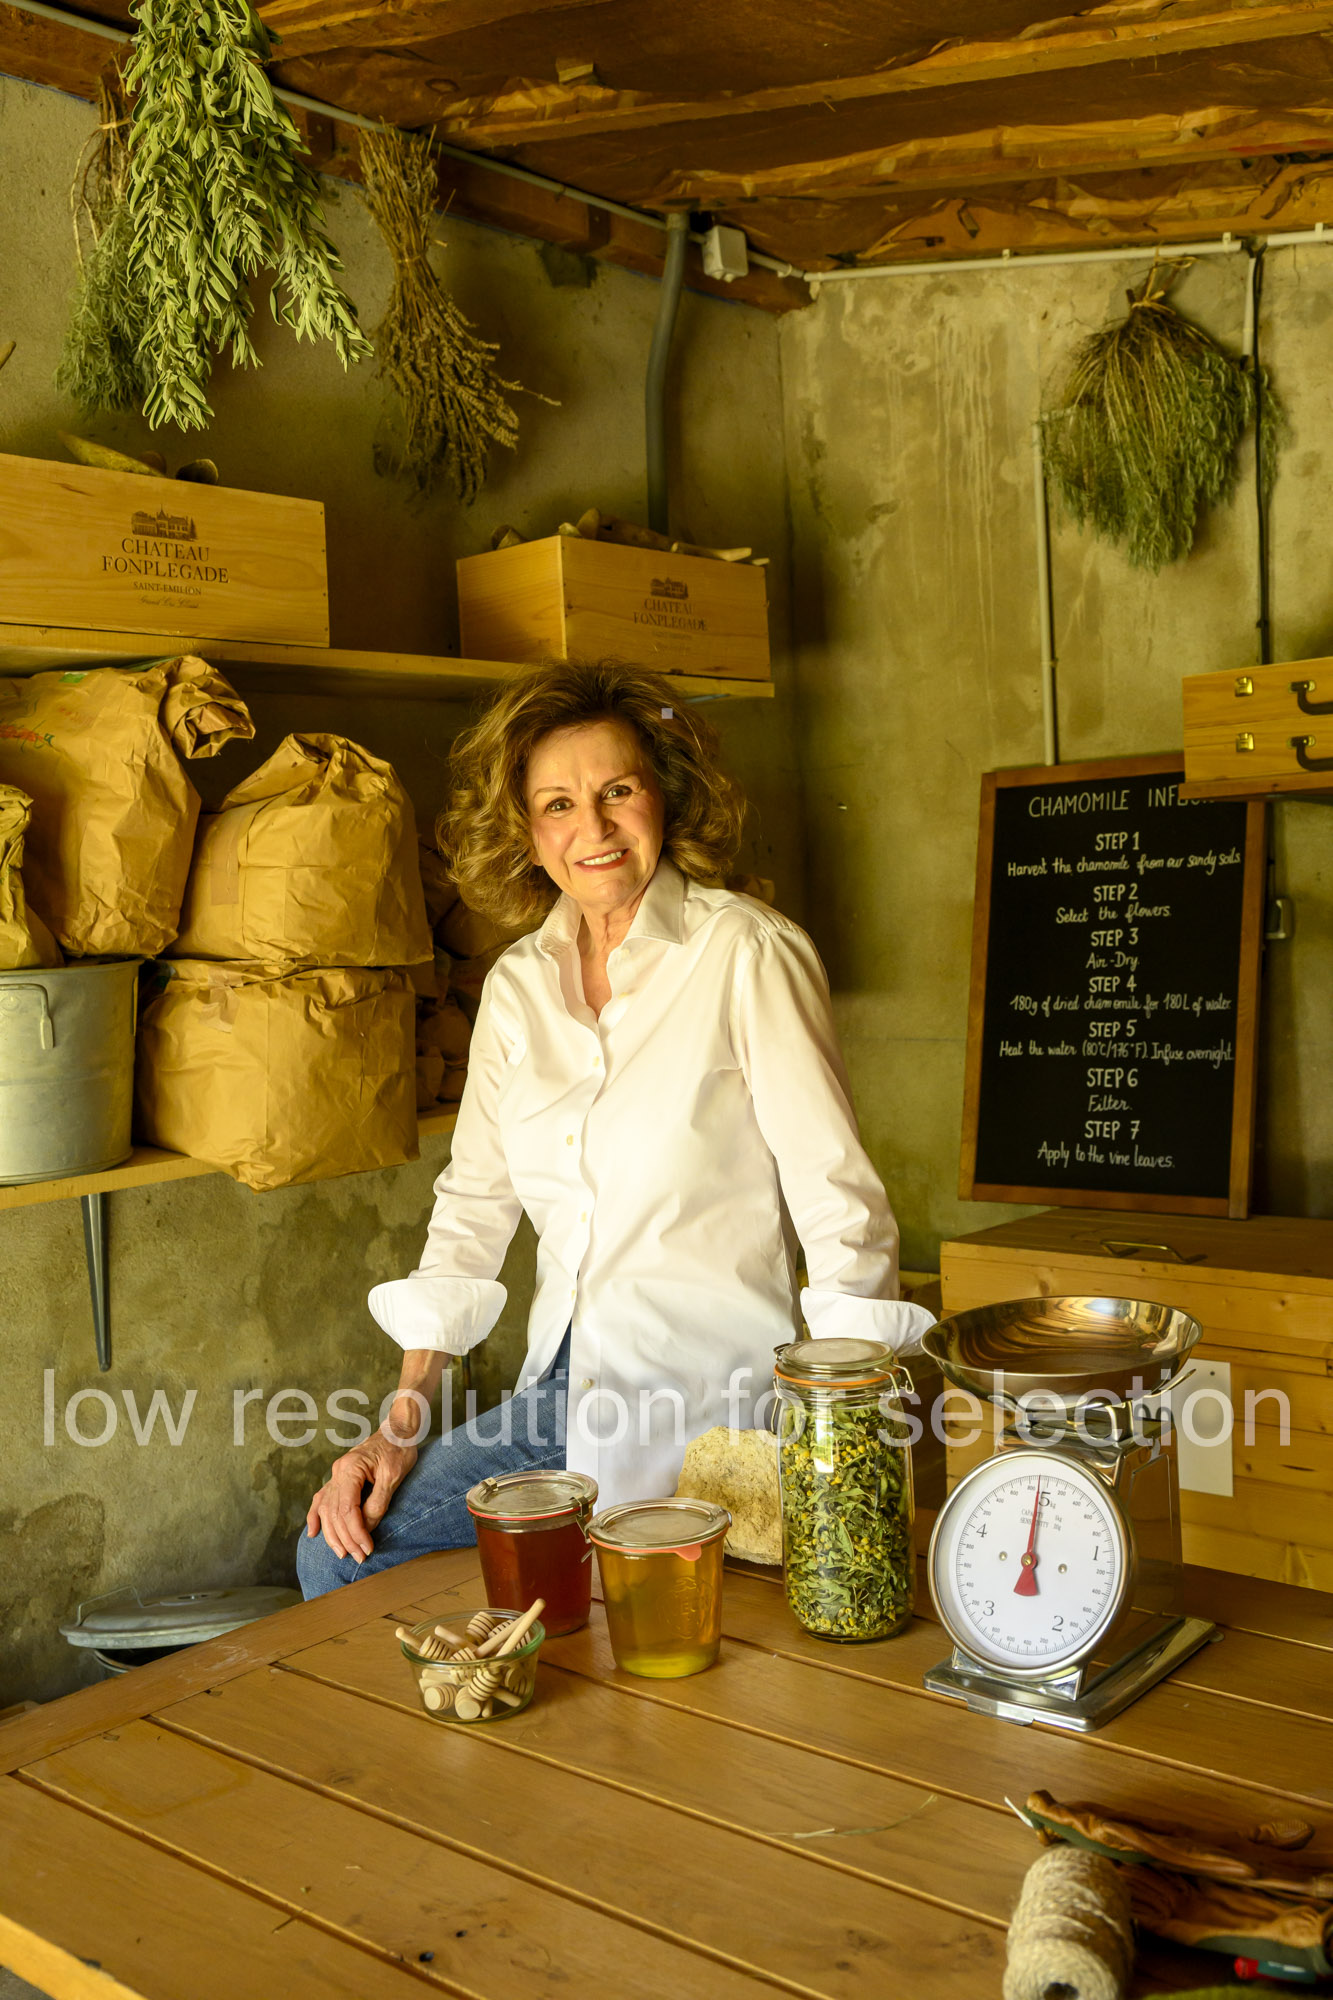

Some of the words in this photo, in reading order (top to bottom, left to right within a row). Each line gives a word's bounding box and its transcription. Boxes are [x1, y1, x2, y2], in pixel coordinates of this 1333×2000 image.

[121, 537, 210, 562] CHATEAU
[102, 555, 229, 584] FONPLEGADE
[133, 581, 202, 595] SAINT-EMILION
[1028, 789, 1131, 818] CHAMOMILE
[1095, 831, 1128, 852] STEP
[1132, 831, 1140, 850] 1
[1007, 857, 1048, 877] Harvest
[1052, 857, 1072, 875] the
[1136, 853, 1164, 876] from
[1187, 849, 1217, 876] sandy
[1093, 884, 1126, 903] STEP
[1128, 882, 1139, 900] 2
[1055, 906, 1089, 924] Select
[1098, 906, 1118, 920] the
[1090, 929, 1124, 947] STEP
[1128, 927, 1139, 945] 3
[1088, 976, 1121, 993] STEP
[1126, 974, 1137, 993] 4
[1009, 994, 1038, 1016] 180g
[1041, 995, 1051, 1018] of
[1053, 994, 1080, 1011] dried
[1084, 994, 1141, 1010] chamomile
[1143, 993, 1159, 1019] for
[1192, 996, 1204, 1018] of
[1088, 1021, 1121, 1038] STEP
[1125, 1019, 1138, 1037] 5
[999, 1040, 1023, 1057] Heat
[1028, 1040, 1045, 1056] the
[1047, 1040, 1077, 1056] water
[1151, 1042, 1184, 1066] Infuse
[1086, 1067, 1124, 1088] STEP
[1127, 1068, 1138, 1087] 6
[1088, 1094, 1133, 1112] Filter.
[1084, 1120, 1121, 1141] STEP
[1130, 1120, 1141, 1140] 7
[1037, 1141, 1070, 1168] Apply
[1075, 1143, 1086, 1162] to
[1088, 1144, 1105, 1164] the
[1109, 1150, 1131, 1166] vine
[976, 1523, 987, 1538] 4
[1093, 1545, 1099, 1561] 1
[982, 1600, 995, 1616] 3
[1051, 1615, 1064, 1632] 2
